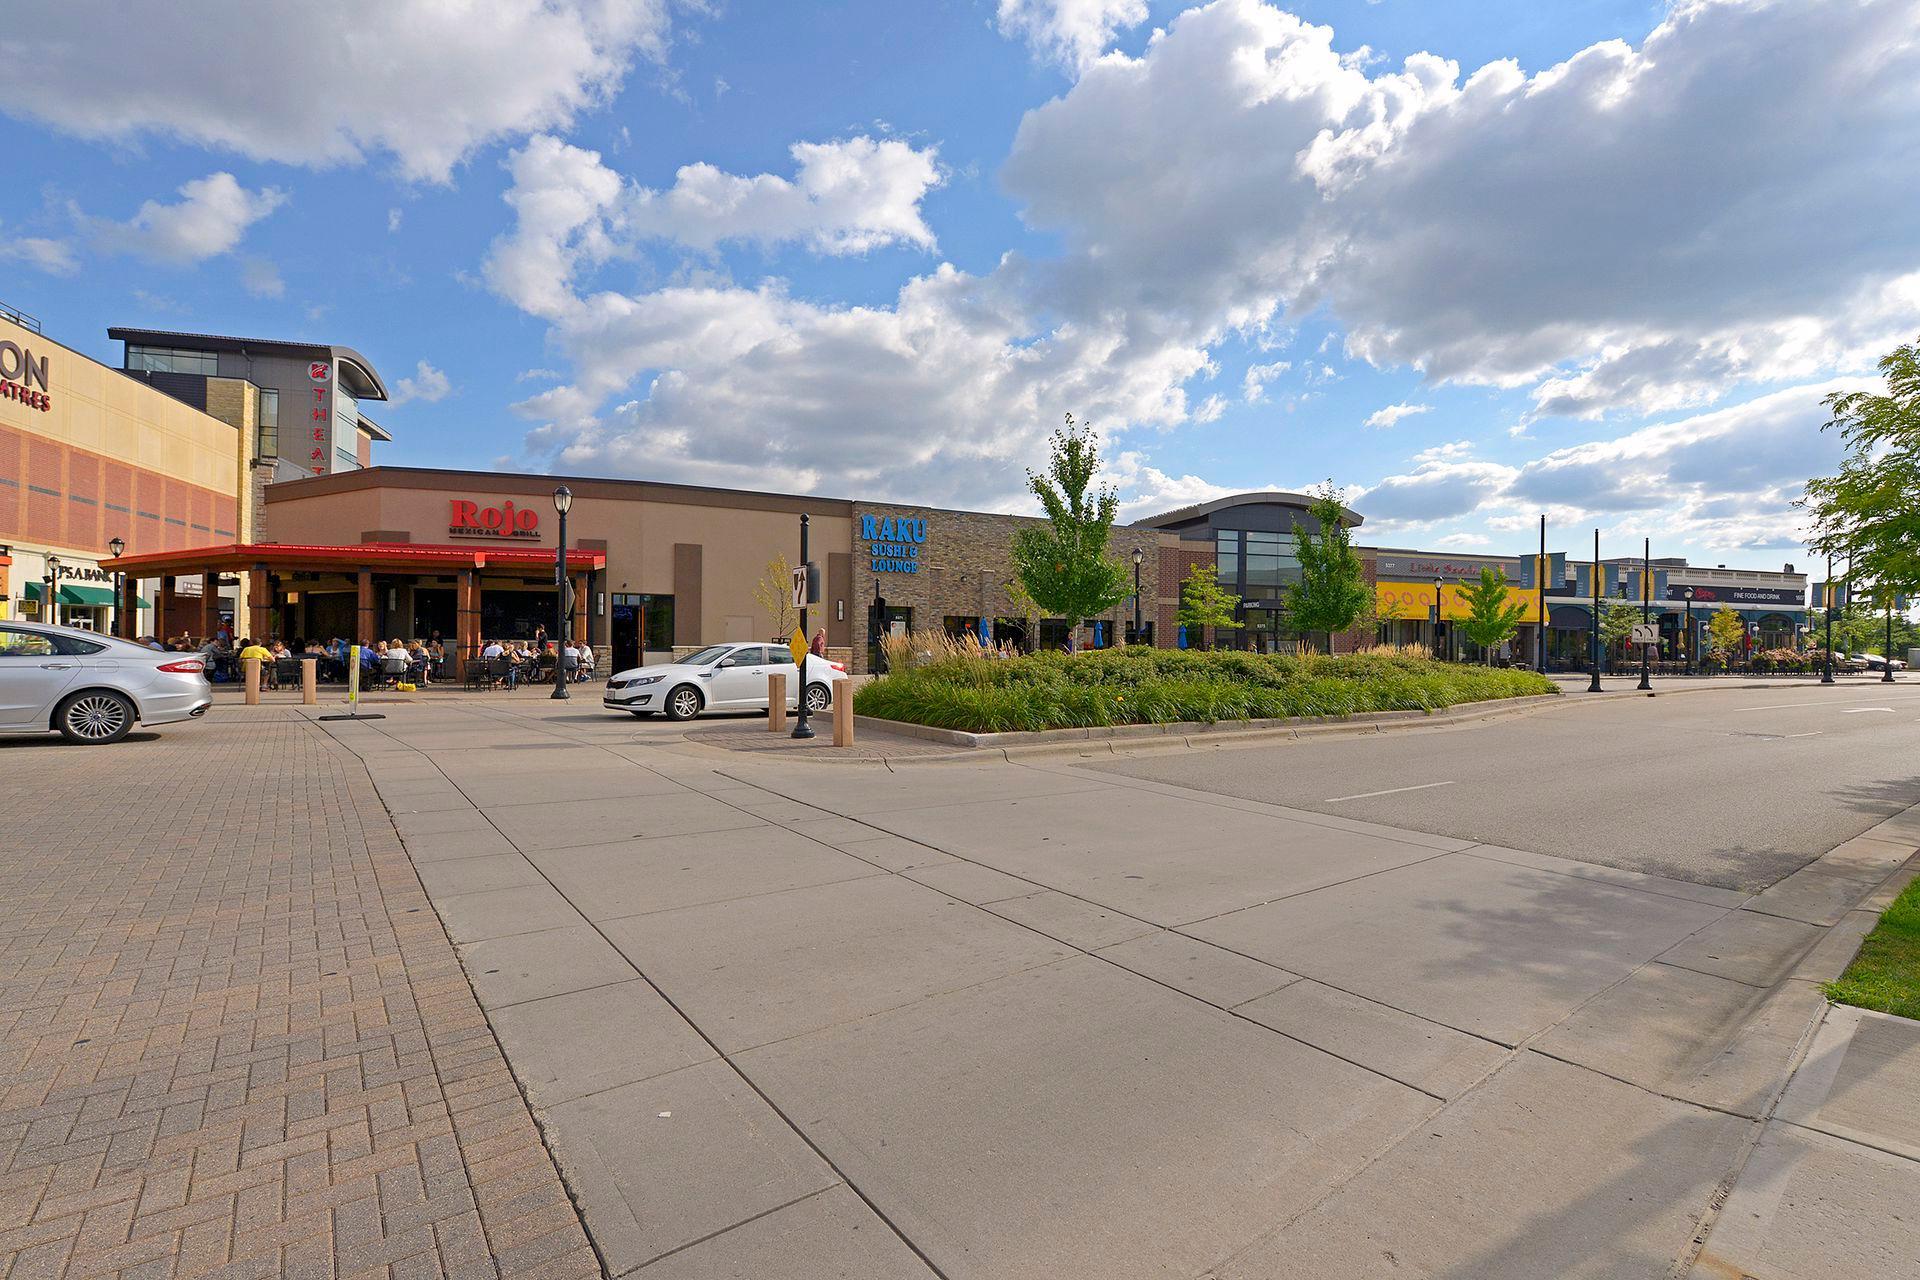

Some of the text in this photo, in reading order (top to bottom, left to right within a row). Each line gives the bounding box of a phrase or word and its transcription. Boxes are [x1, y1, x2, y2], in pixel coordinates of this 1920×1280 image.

[0, 341, 48, 392] ON
[0, 379, 51, 412] ATRES
[449, 500, 538, 537] Rojo
[861, 514, 928, 544] RAKU
[449, 527, 541, 538] MEXICAN GRILL
[871, 543, 919, 559] SUSHI &
[871, 559, 920, 574] LOUNGE
[1733, 591, 1744, 599] FINE
